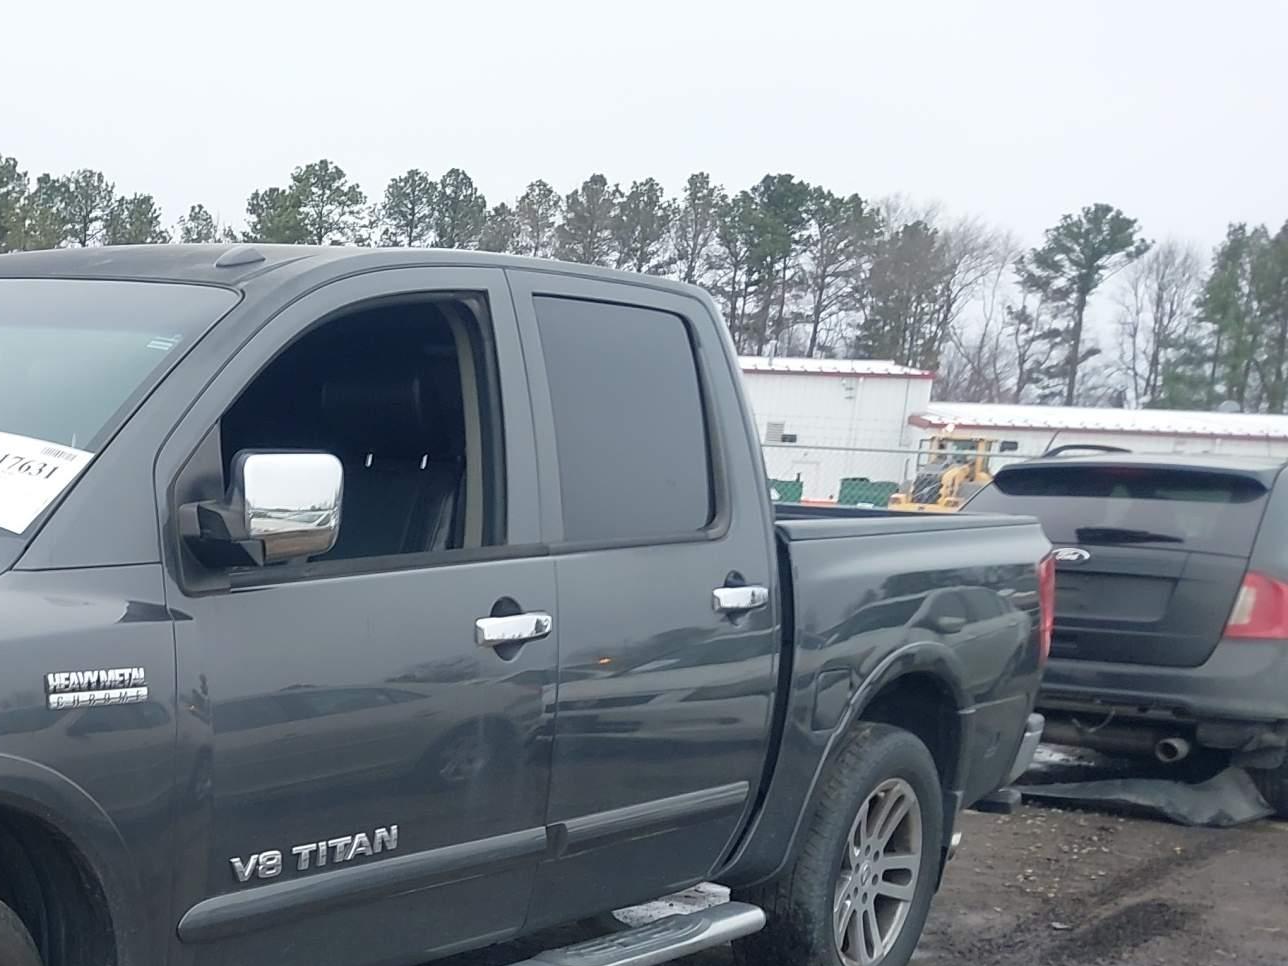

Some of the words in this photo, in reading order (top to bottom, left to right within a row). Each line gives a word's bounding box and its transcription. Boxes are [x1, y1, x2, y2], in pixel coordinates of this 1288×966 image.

[46, 670, 99, 692] HEAVY
[99, 667, 147, 689] METAL
[230, 850, 282, 882] V8
[292, 825, 398, 871] TITAN
